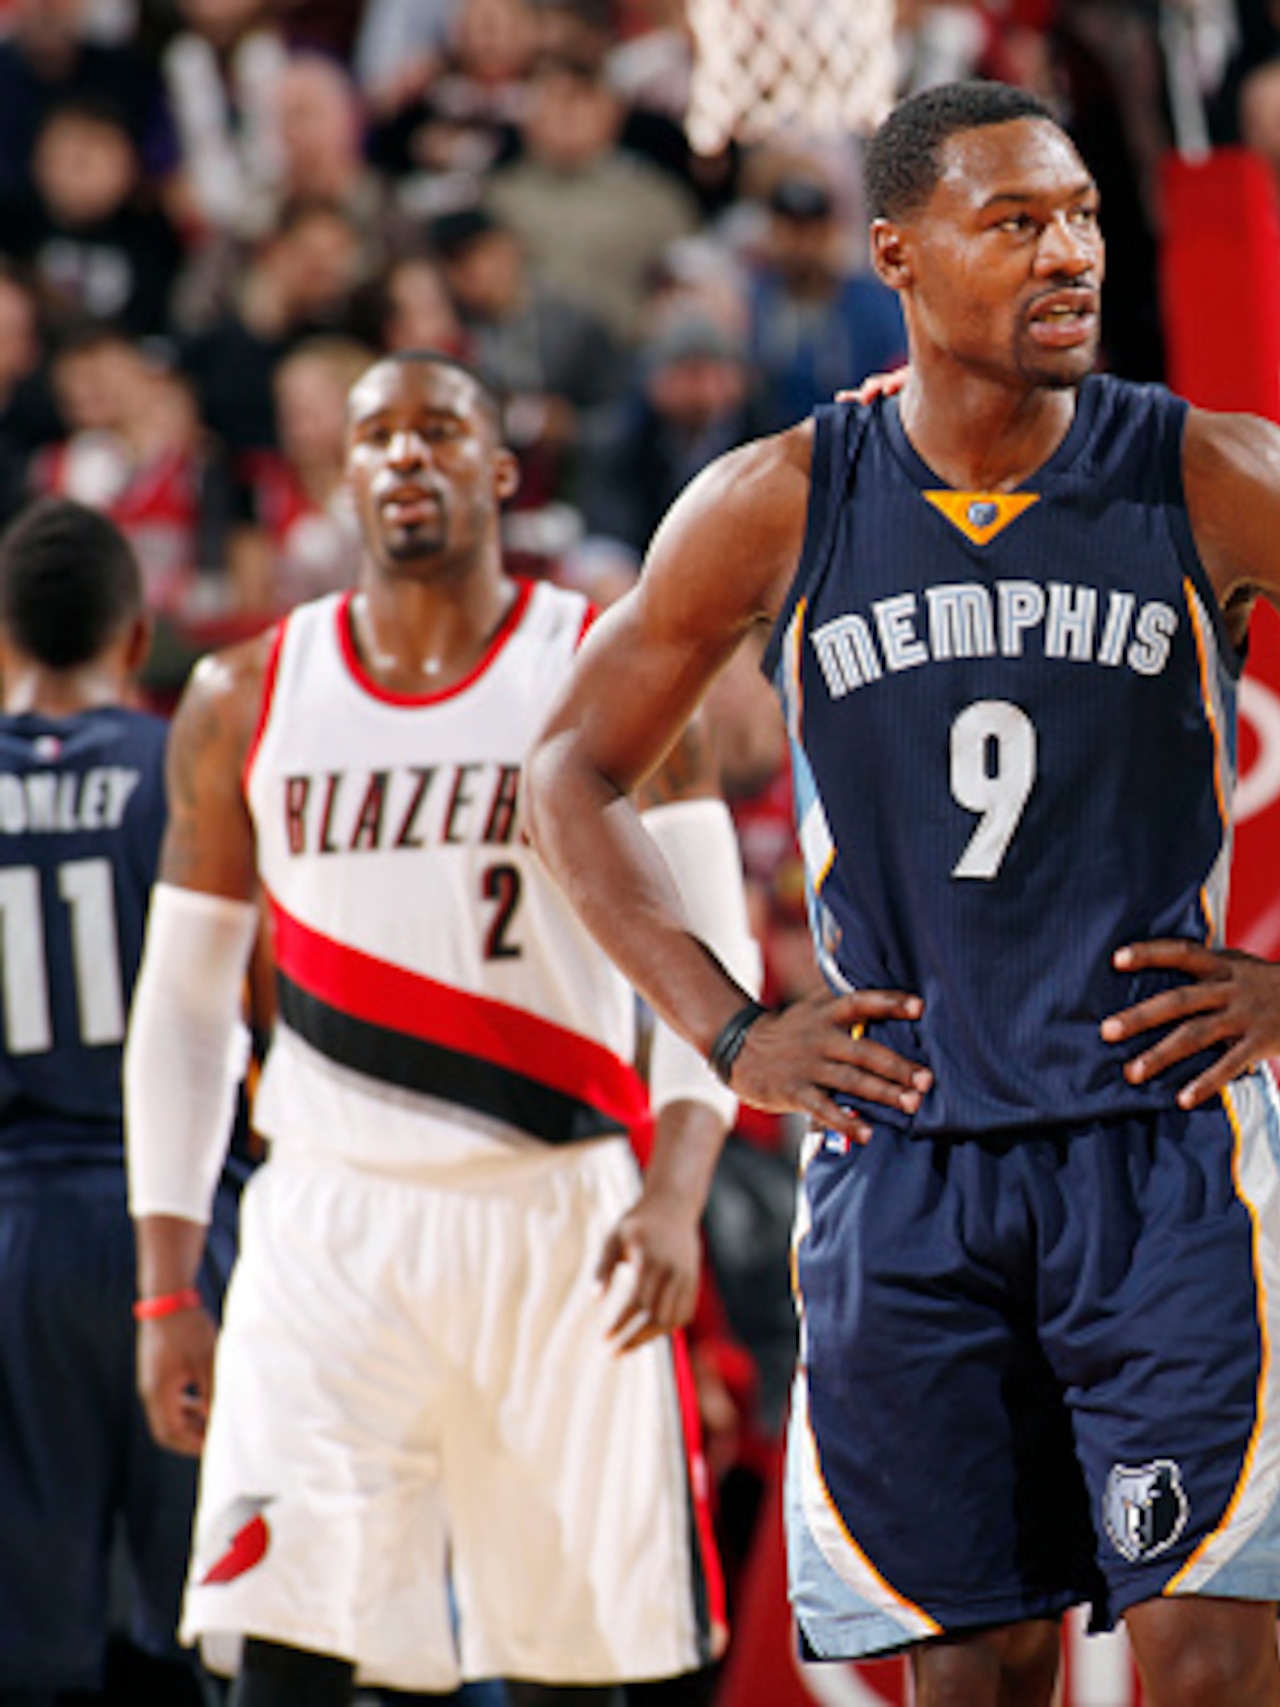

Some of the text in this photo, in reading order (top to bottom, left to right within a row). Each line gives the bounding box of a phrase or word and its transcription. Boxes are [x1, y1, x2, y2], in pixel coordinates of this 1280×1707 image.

[811, 580, 1178, 697] MEMPHIS
[285, 764, 531, 856] BLAZER
[950, 700, 1036, 878] 9
[0, 858, 125, 1054] 11
[481, 863, 522, 961] 2
